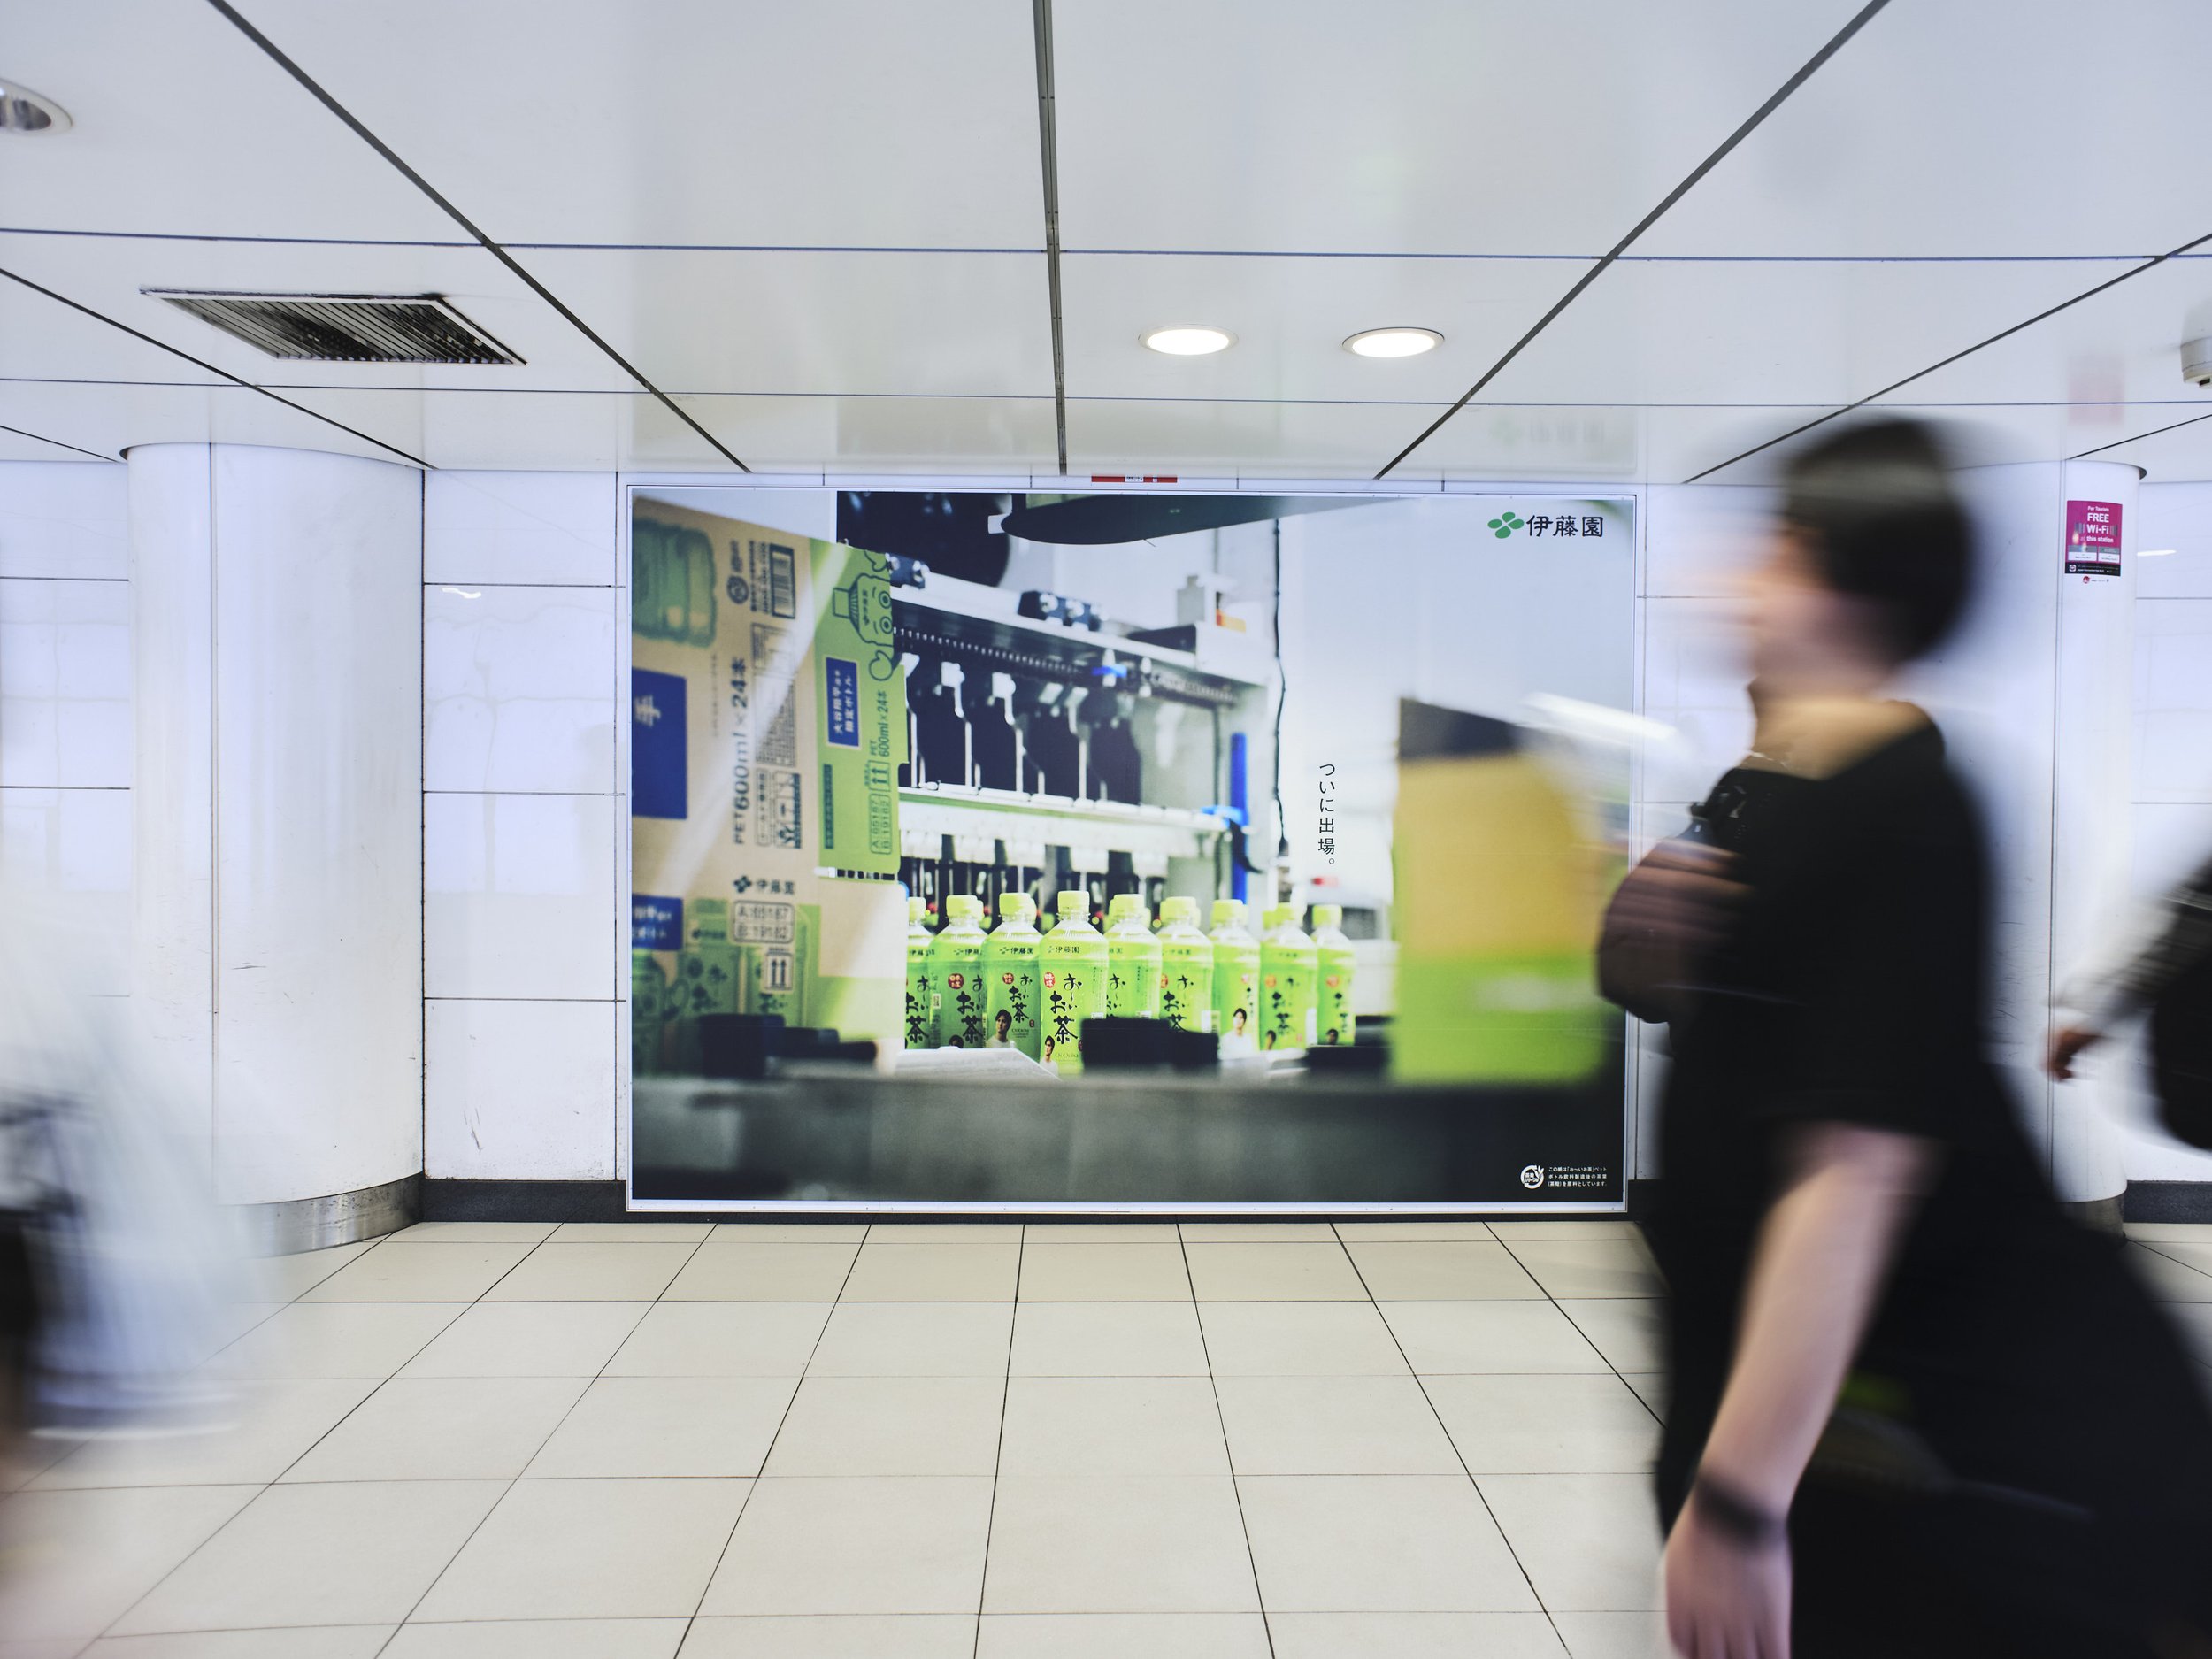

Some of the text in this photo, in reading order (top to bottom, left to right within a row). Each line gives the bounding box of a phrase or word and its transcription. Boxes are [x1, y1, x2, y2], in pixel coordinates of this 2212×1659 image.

[1526, 515, 1604, 537] 伊藤園
[2087, 512, 2109, 523] FREE
[2086, 524, 2109, 534] Wi-Fi
[1318, 764, 1335, 864] ついに出場。
[1049, 990, 1078, 1044] お茶
